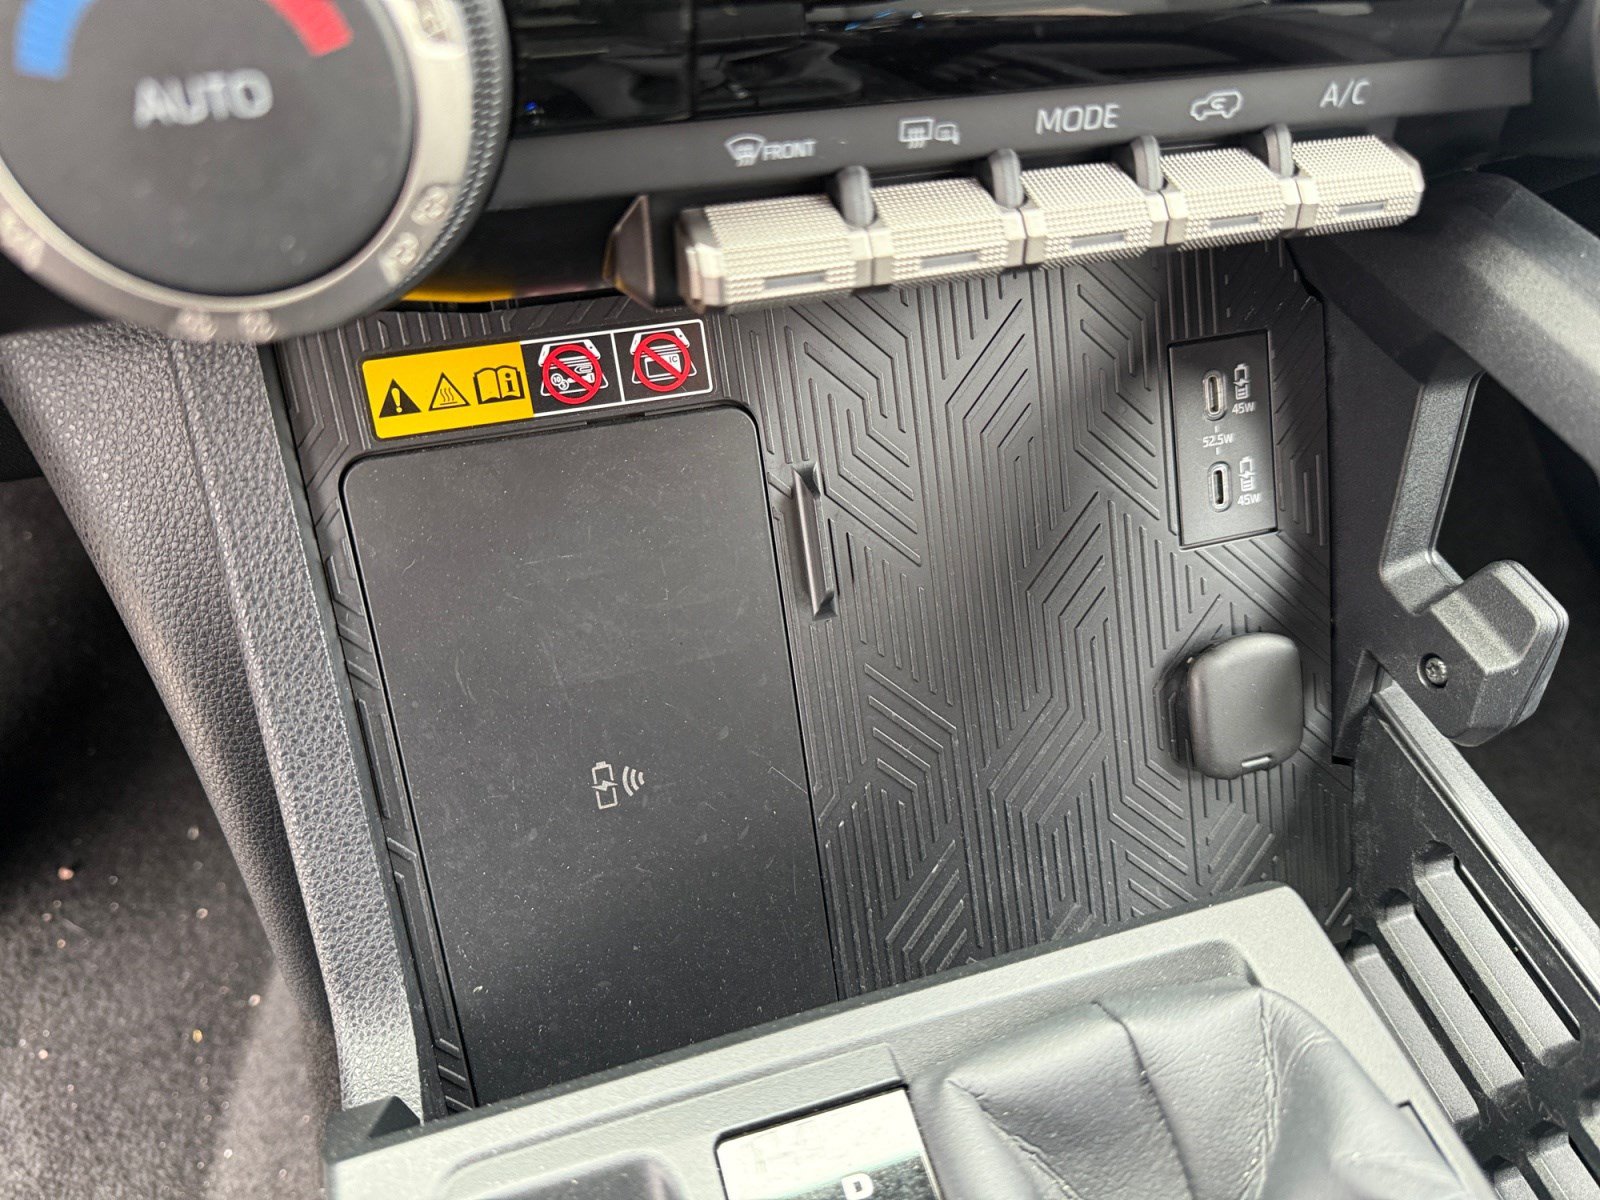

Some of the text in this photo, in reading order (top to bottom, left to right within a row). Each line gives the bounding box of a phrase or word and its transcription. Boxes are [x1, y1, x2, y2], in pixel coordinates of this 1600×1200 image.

[134, 68, 274, 129] AUTO
[1320, 79, 1370, 108] A/C
[1035, 103, 1120, 134] MODE
[763, 139, 816, 161] FRONT
[1231, 401, 1257, 415] 45W
[1202, 433, 1235, 448] 52.5W
[1237, 492, 1262, 506] 45W
